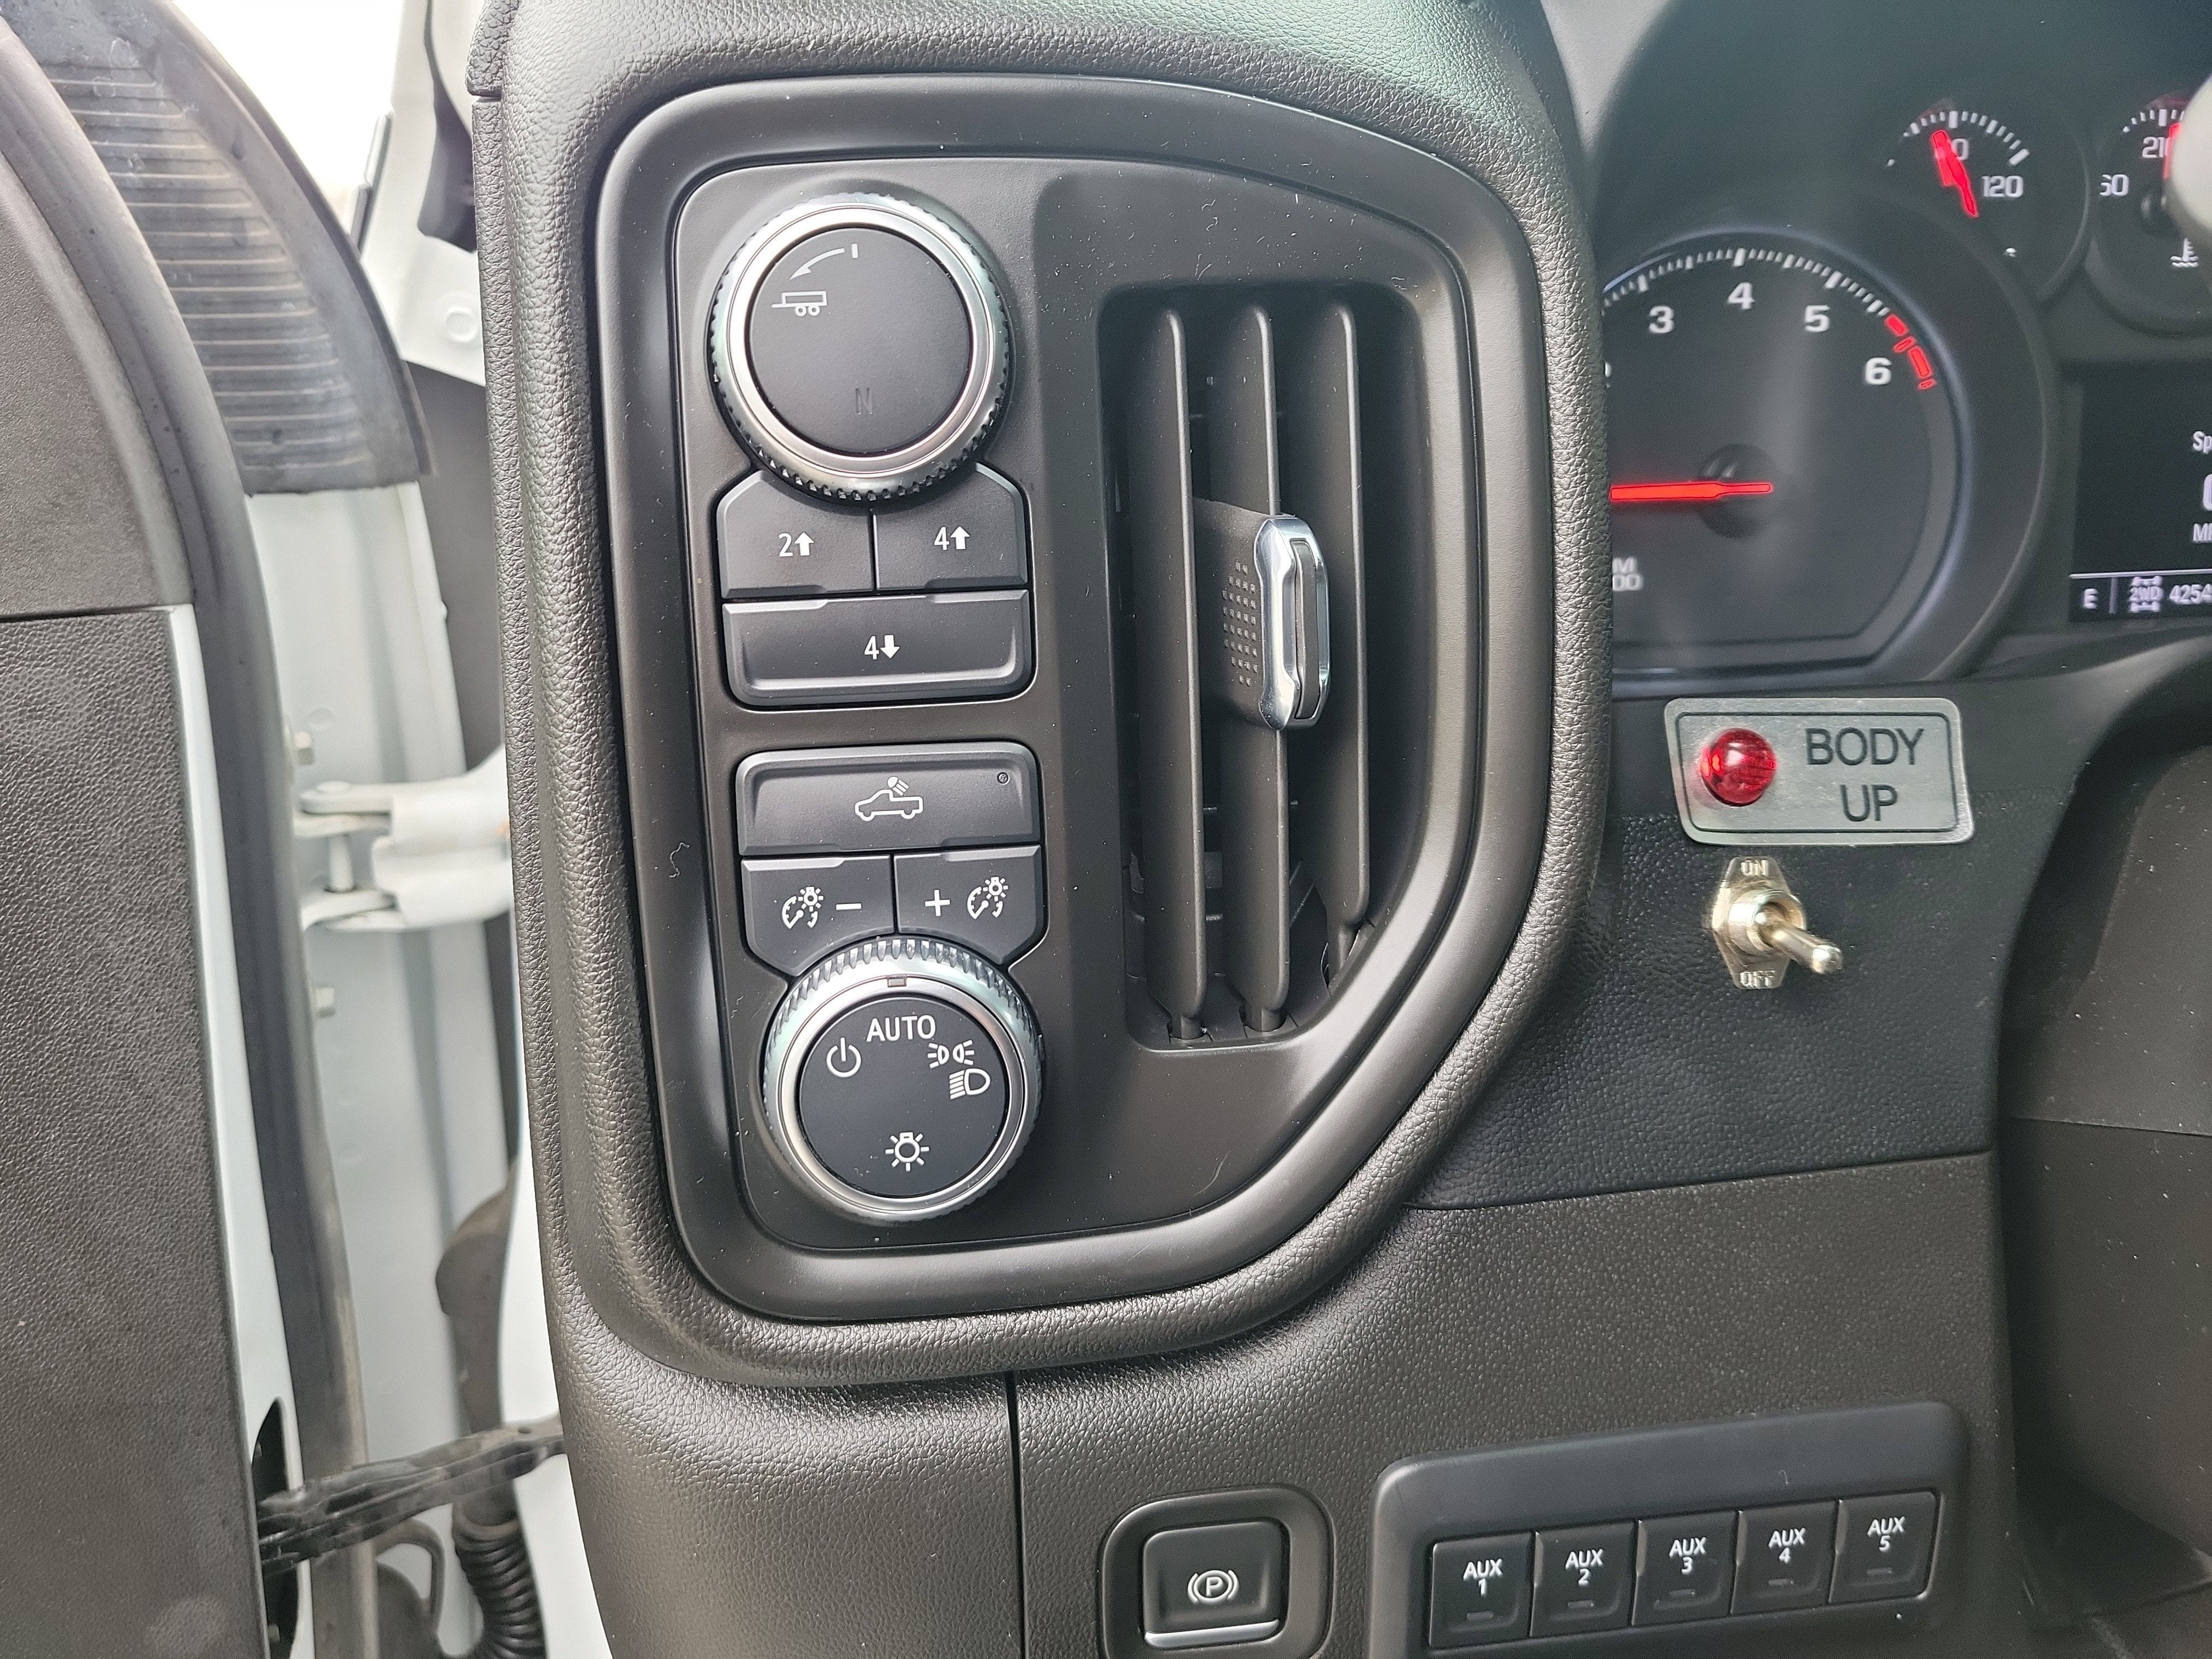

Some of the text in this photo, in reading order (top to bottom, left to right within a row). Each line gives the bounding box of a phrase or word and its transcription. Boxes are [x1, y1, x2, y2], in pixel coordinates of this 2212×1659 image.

[1981, 175, 2024, 198] 120
[1728, 282, 1755, 310] 4
[1649, 305, 1674, 334] 3
[1804, 304, 1831, 332] 5
[1865, 357, 1892, 385] 6
[2083, 588, 2098, 609] E
[2130, 586, 2164, 602] 2WD
[1805, 727, 1925, 766] BODY
[1840, 784, 1898, 822] UP
[1740, 859, 1769, 877] ON
[1739, 970, 1776, 989] OFF
[866, 1014, 936, 1042] AUTO
[1867, 1516, 1906, 1537] AUX
[1669, 1537, 1707, 1558] AUX
[1768, 1528, 1806, 1548] AUX
[1878, 1535, 1891, 1553] 5
[1565, 1548, 1603, 1570] AUX
[1681, 1556, 1694, 1576] 3
[1779, 1547, 1791, 1564] 4
[1463, 1558, 1503, 1581] AUX
[1578, 1568, 1590, 1587] 2
[1477, 1578, 1488, 1596] 1
